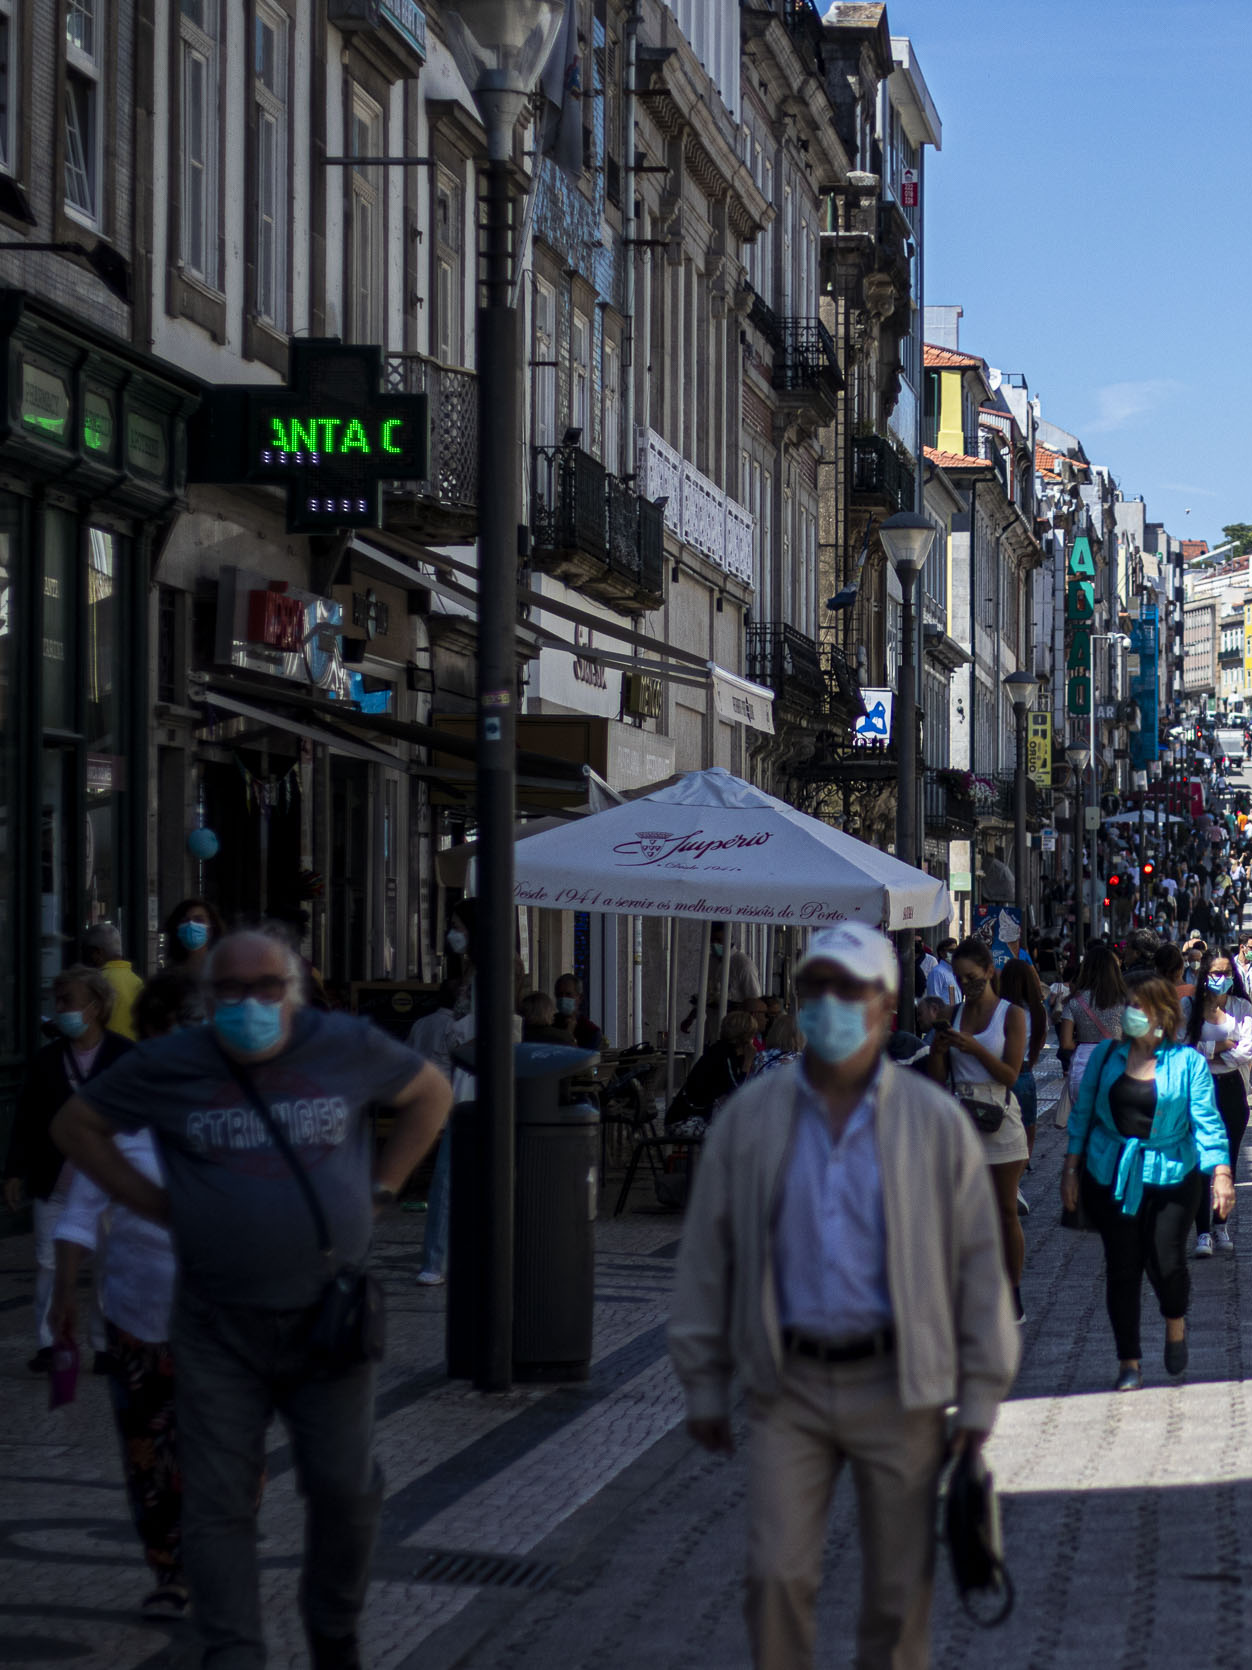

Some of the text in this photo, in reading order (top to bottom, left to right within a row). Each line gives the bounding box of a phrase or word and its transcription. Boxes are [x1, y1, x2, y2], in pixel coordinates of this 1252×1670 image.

[655, 830, 773, 864] Império
[554, 887, 602, 906] 1941
[602, 898, 613, 906] a
[615, 898, 653, 910] servir
[656, 900, 671, 911] os
[673, 898, 732, 915] melhores
[777, 904, 794, 919] do
